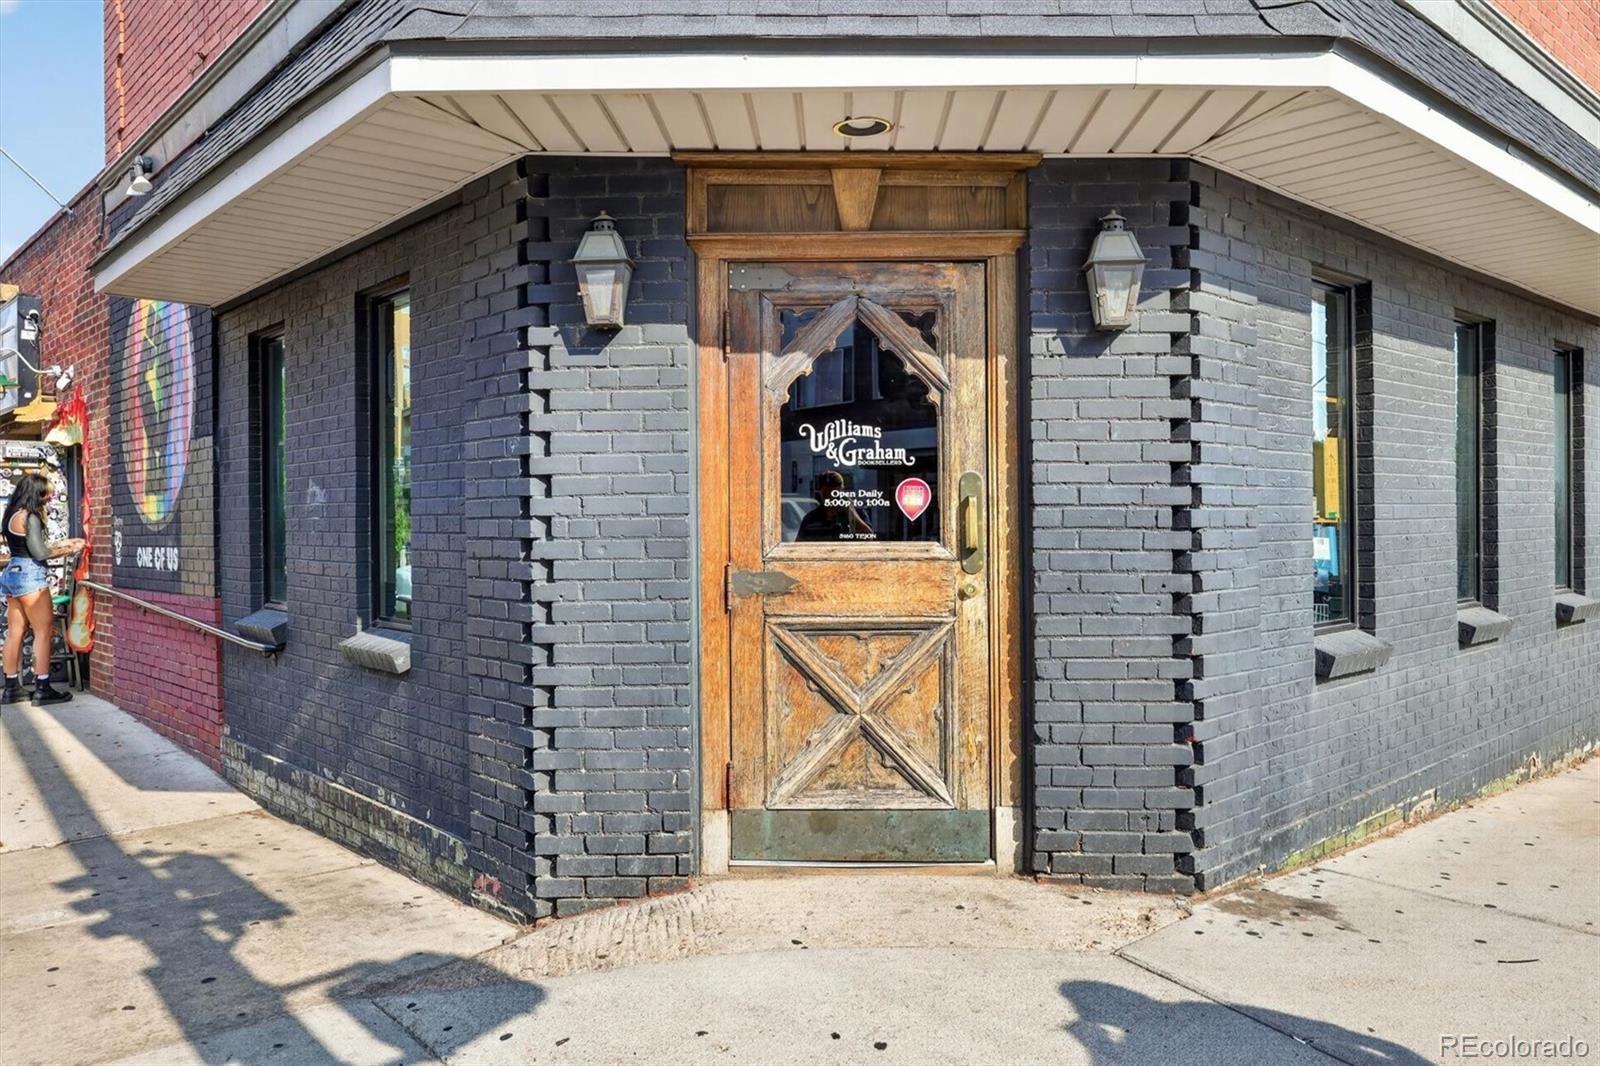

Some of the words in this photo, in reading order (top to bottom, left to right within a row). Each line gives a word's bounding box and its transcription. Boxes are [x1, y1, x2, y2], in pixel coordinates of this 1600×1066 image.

[799, 419, 882, 452] Williams
[831, 490, 856, 498] Open
[858, 489, 884, 499] Daily
[853, 499, 864, 507] to
[866, 499, 890, 507] 1:00a
[136, 547, 153, 568] ONE
[154, 547, 165, 571] OF
[166, 547, 179, 571] US
